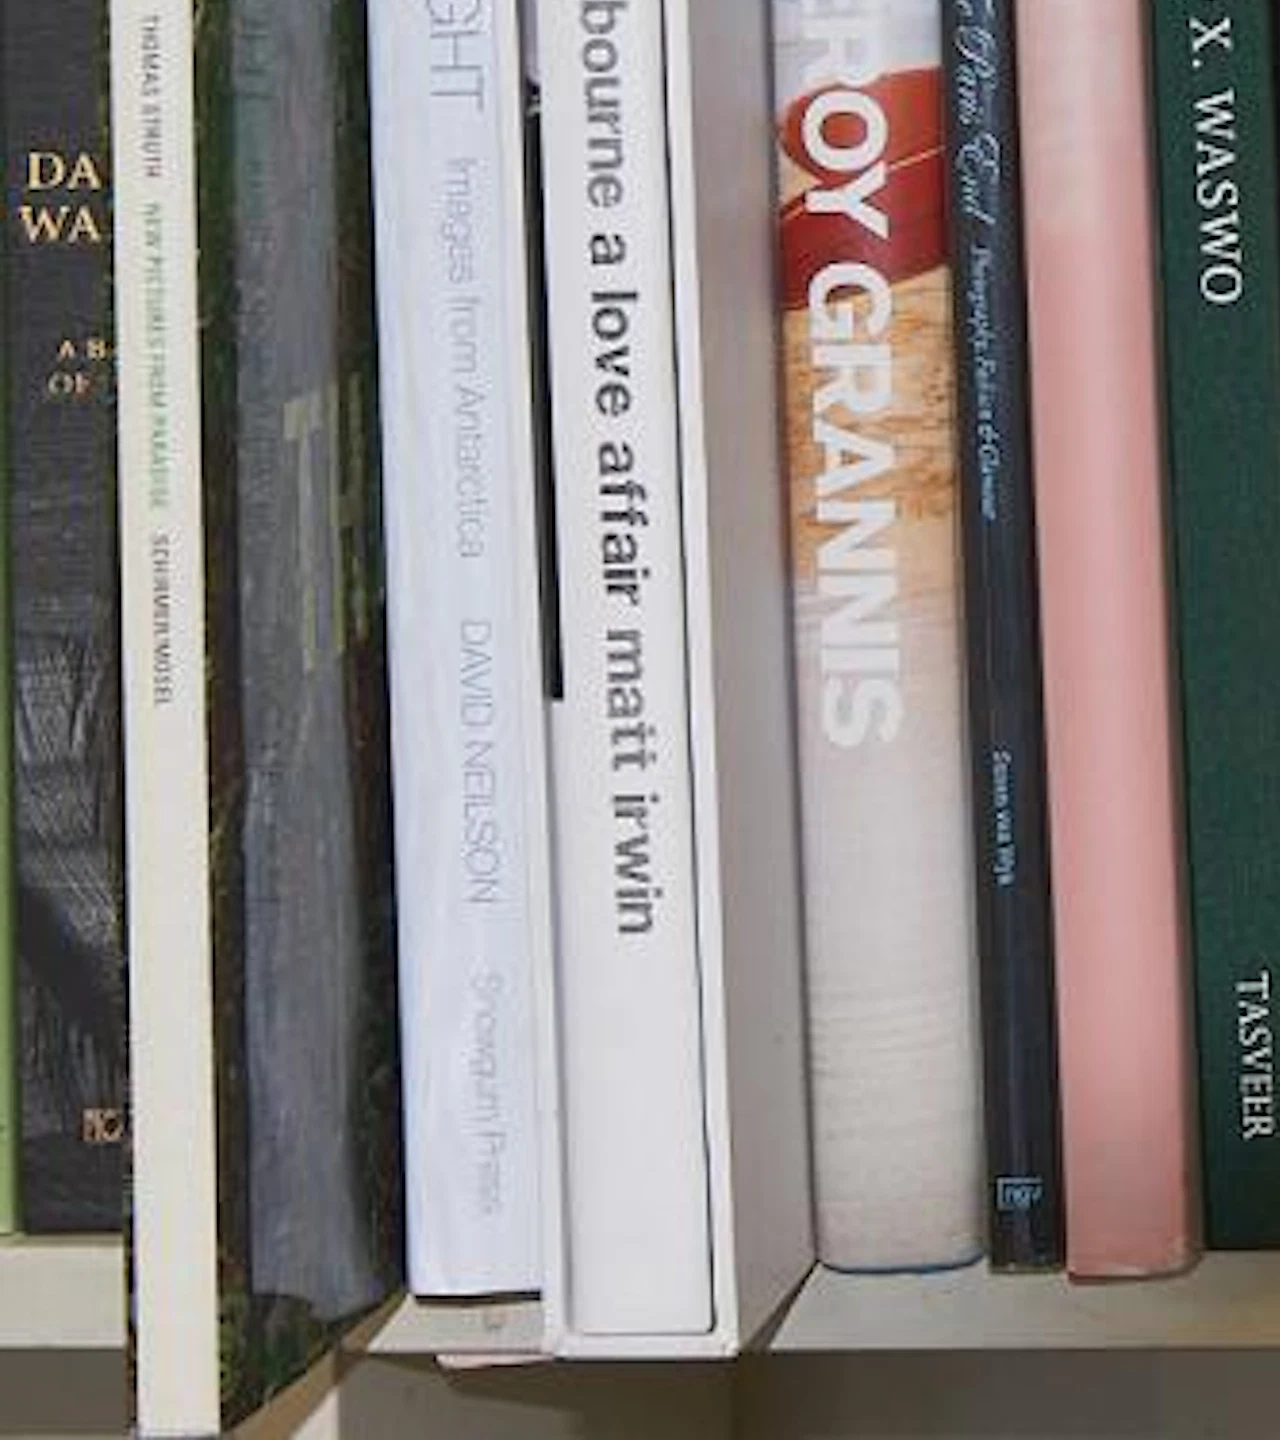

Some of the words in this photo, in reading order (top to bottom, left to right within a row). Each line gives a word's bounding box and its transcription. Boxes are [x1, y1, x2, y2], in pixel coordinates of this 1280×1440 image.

[1187, 15, 1233, 69] X.
[588, 233, 627, 267] a
[1192, 88, 1243, 306] WASWO
[590, 289, 640, 417] love
[456, 383, 488, 559] Antarctica
[599, 440, 650, 607] affair
[806, 262, 905, 748] GRANNIS
[460, 619, 493, 727] DAVID
[606, 628, 658, 772] matt
[463, 742, 501, 904] NEILSON
[612, 792, 665, 936] irwin
[1237, 969, 1274, 1141] TASVEER
